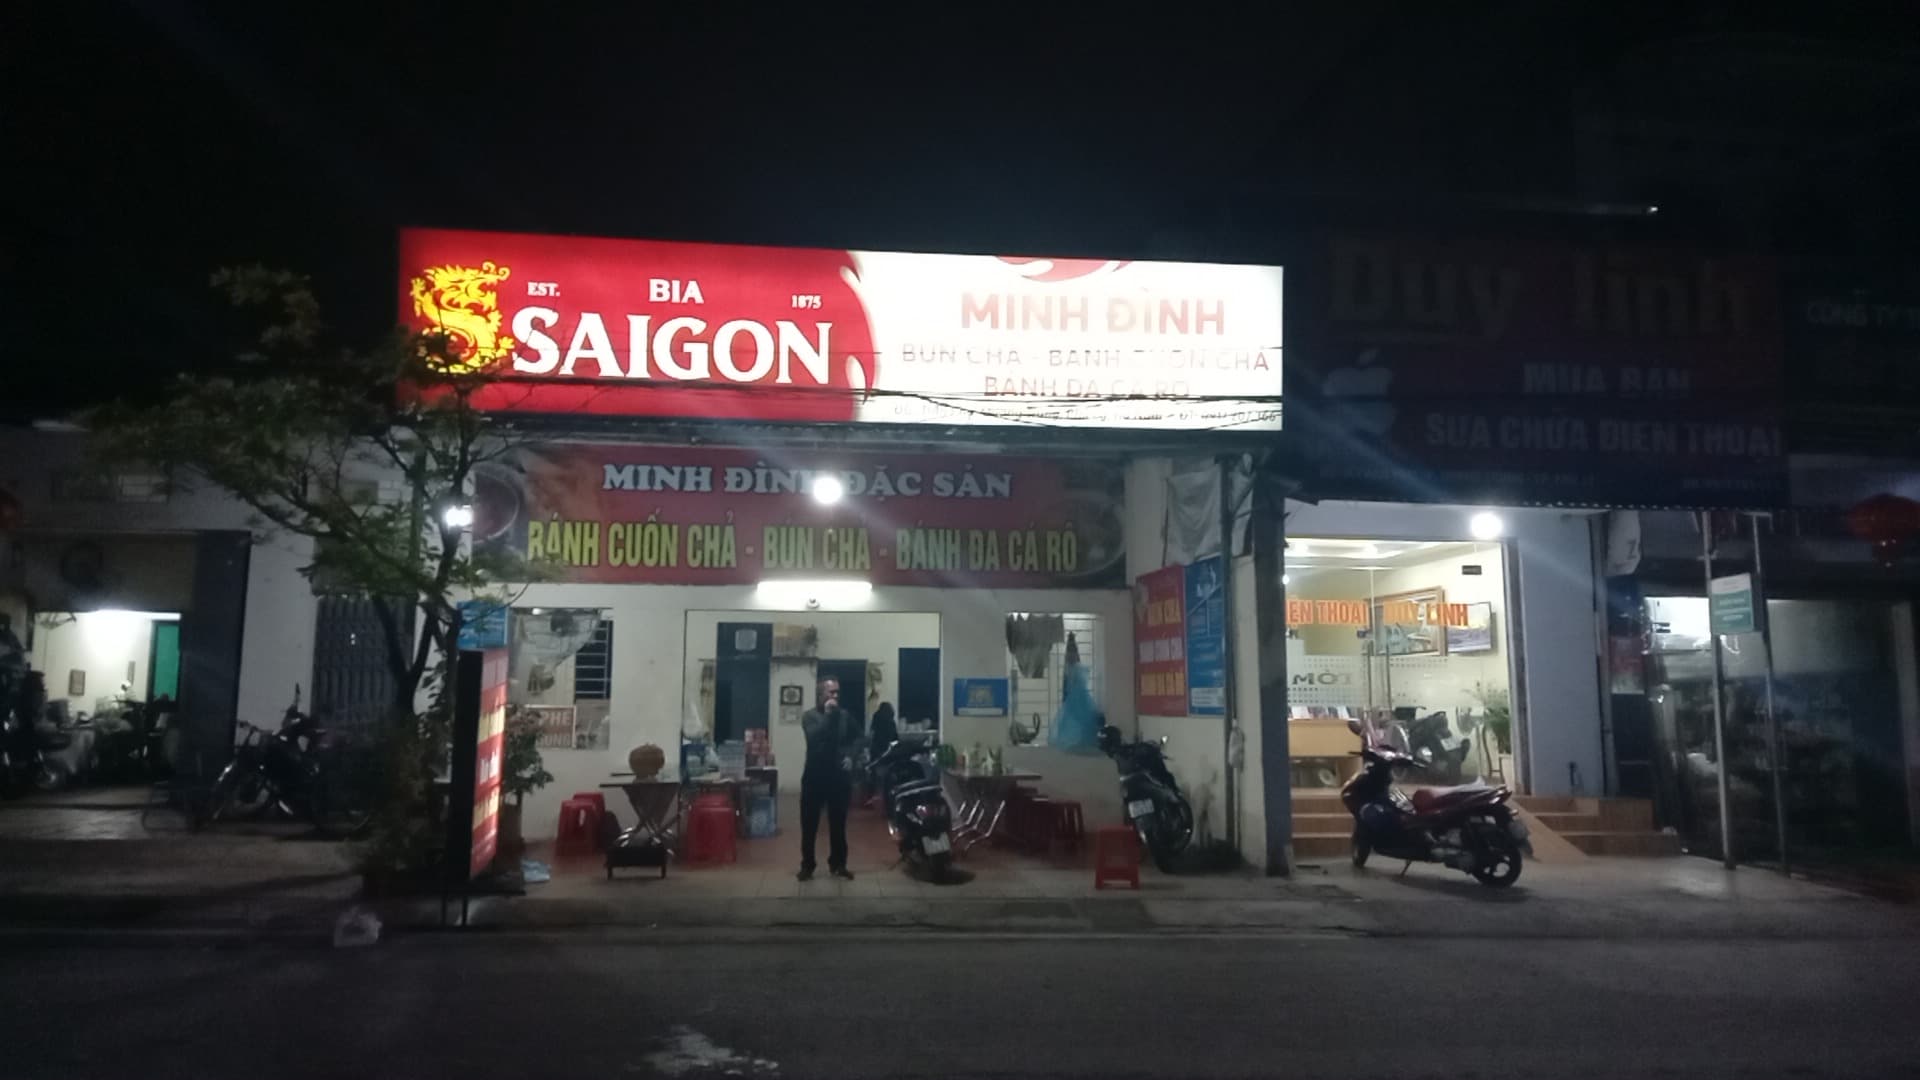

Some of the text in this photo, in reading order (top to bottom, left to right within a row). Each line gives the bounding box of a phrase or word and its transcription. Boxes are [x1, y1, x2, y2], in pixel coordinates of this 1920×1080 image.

[527, 281, 560, 297] EST.
[649, 278, 704, 304] BIA
[792, 295, 822, 310] 1875
[961, 288, 1226, 336] MINH ĐÌNH
[512, 306, 832, 385] SAIGON
[603, 464, 713, 492] MINH
[608, 507, 679, 568] CUỐN
[687, 510, 738, 569] CHẢ
[896, 519, 961, 570] BÁNH
